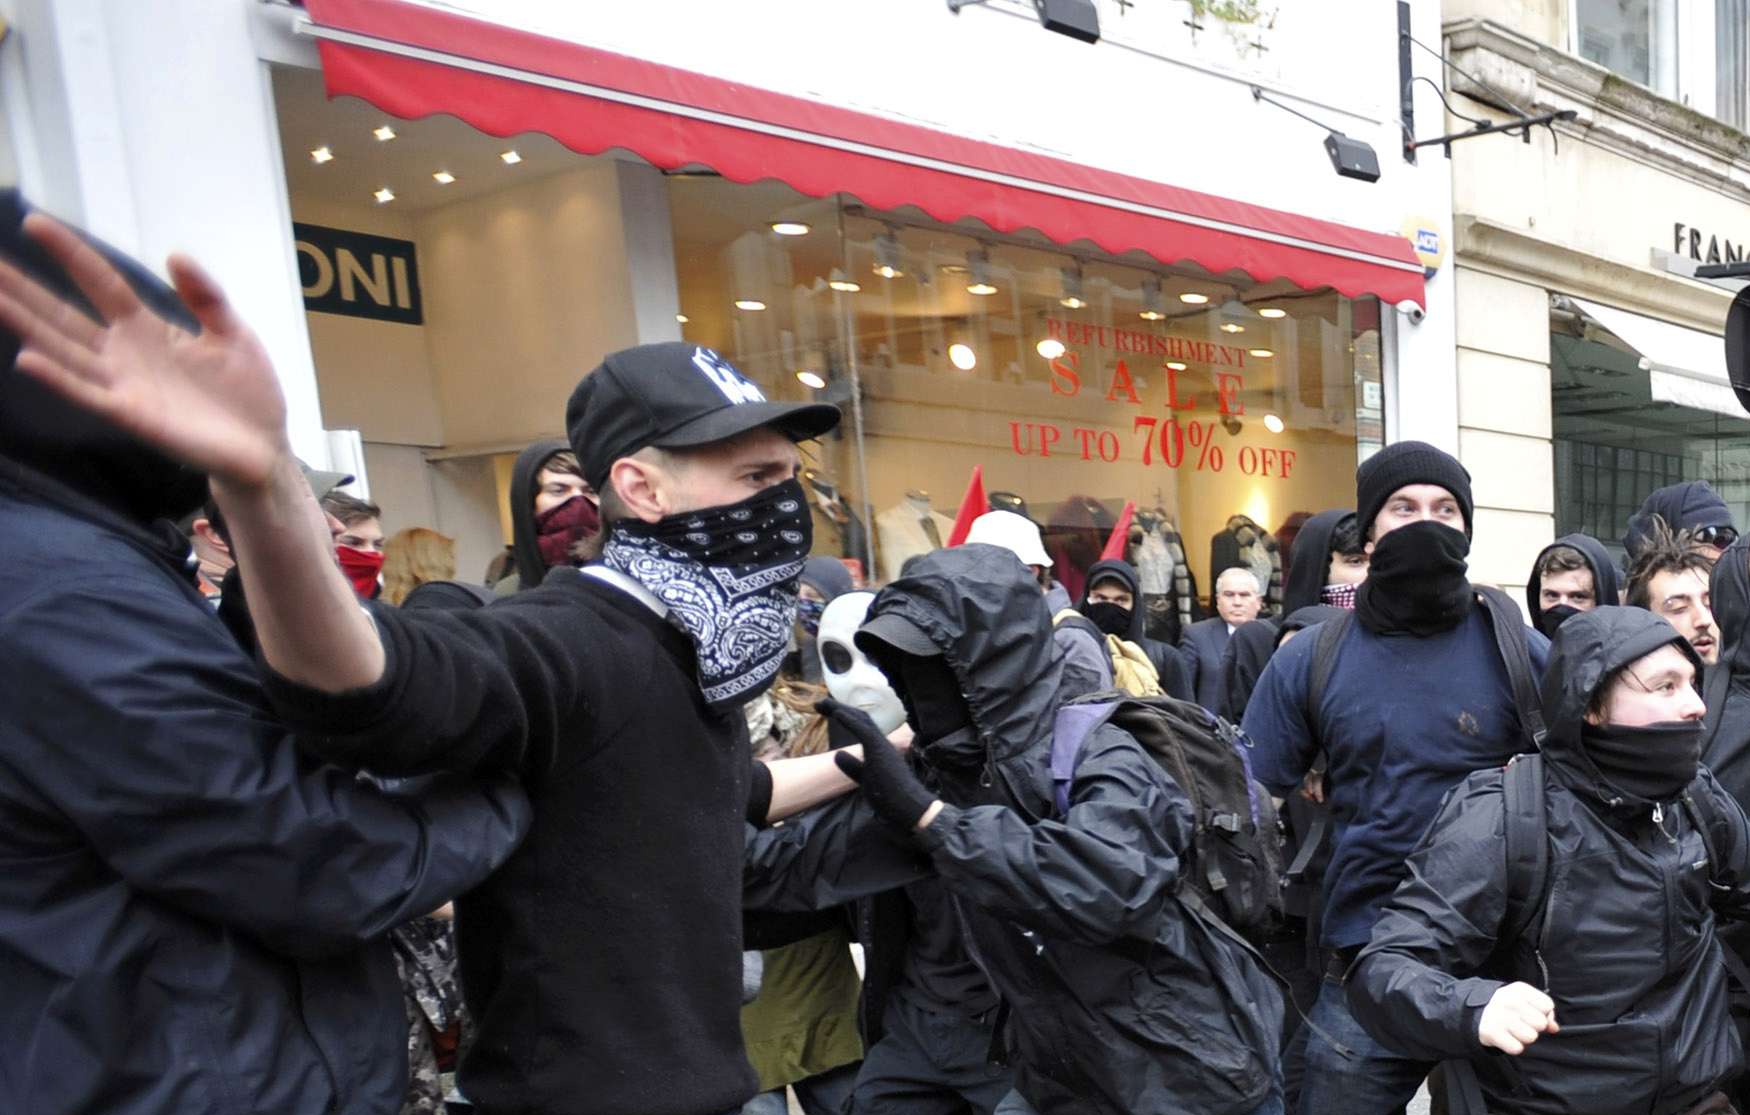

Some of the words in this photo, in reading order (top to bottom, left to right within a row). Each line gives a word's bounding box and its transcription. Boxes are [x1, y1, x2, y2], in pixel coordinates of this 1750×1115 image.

[1046, 318, 1247, 368] REFURBISHMENT
[1050, 350, 1245, 417] SALE
[1008, 420, 1061, 458] UP
[1073, 426, 1121, 463] TO
[1133, 415, 1224, 473] 70%
[1238, 445, 1297, 479] OFF
